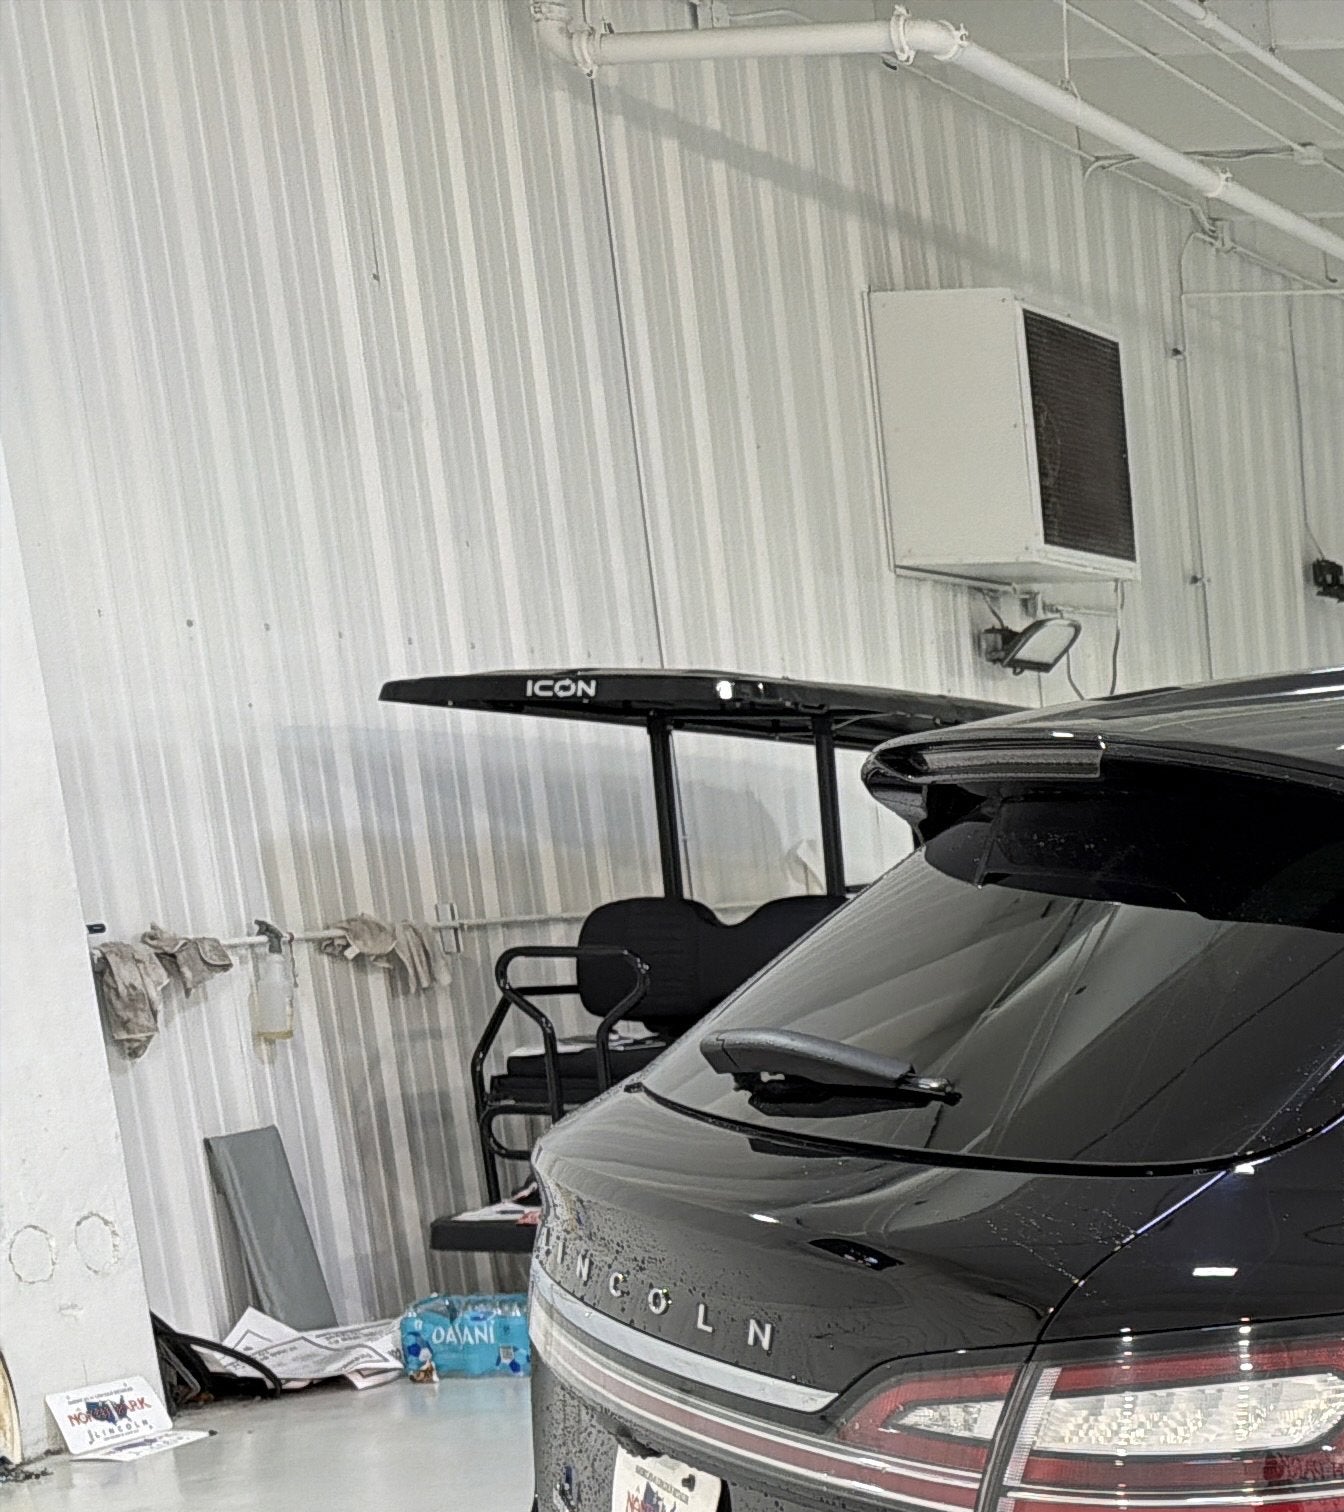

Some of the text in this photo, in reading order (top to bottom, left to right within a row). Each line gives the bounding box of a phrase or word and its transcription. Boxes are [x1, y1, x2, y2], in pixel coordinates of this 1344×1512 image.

[526, 679, 597, 697] ICON
[431, 1319, 497, 1346] DASANI
[94, 1419, 149, 1439] LINCOLN
